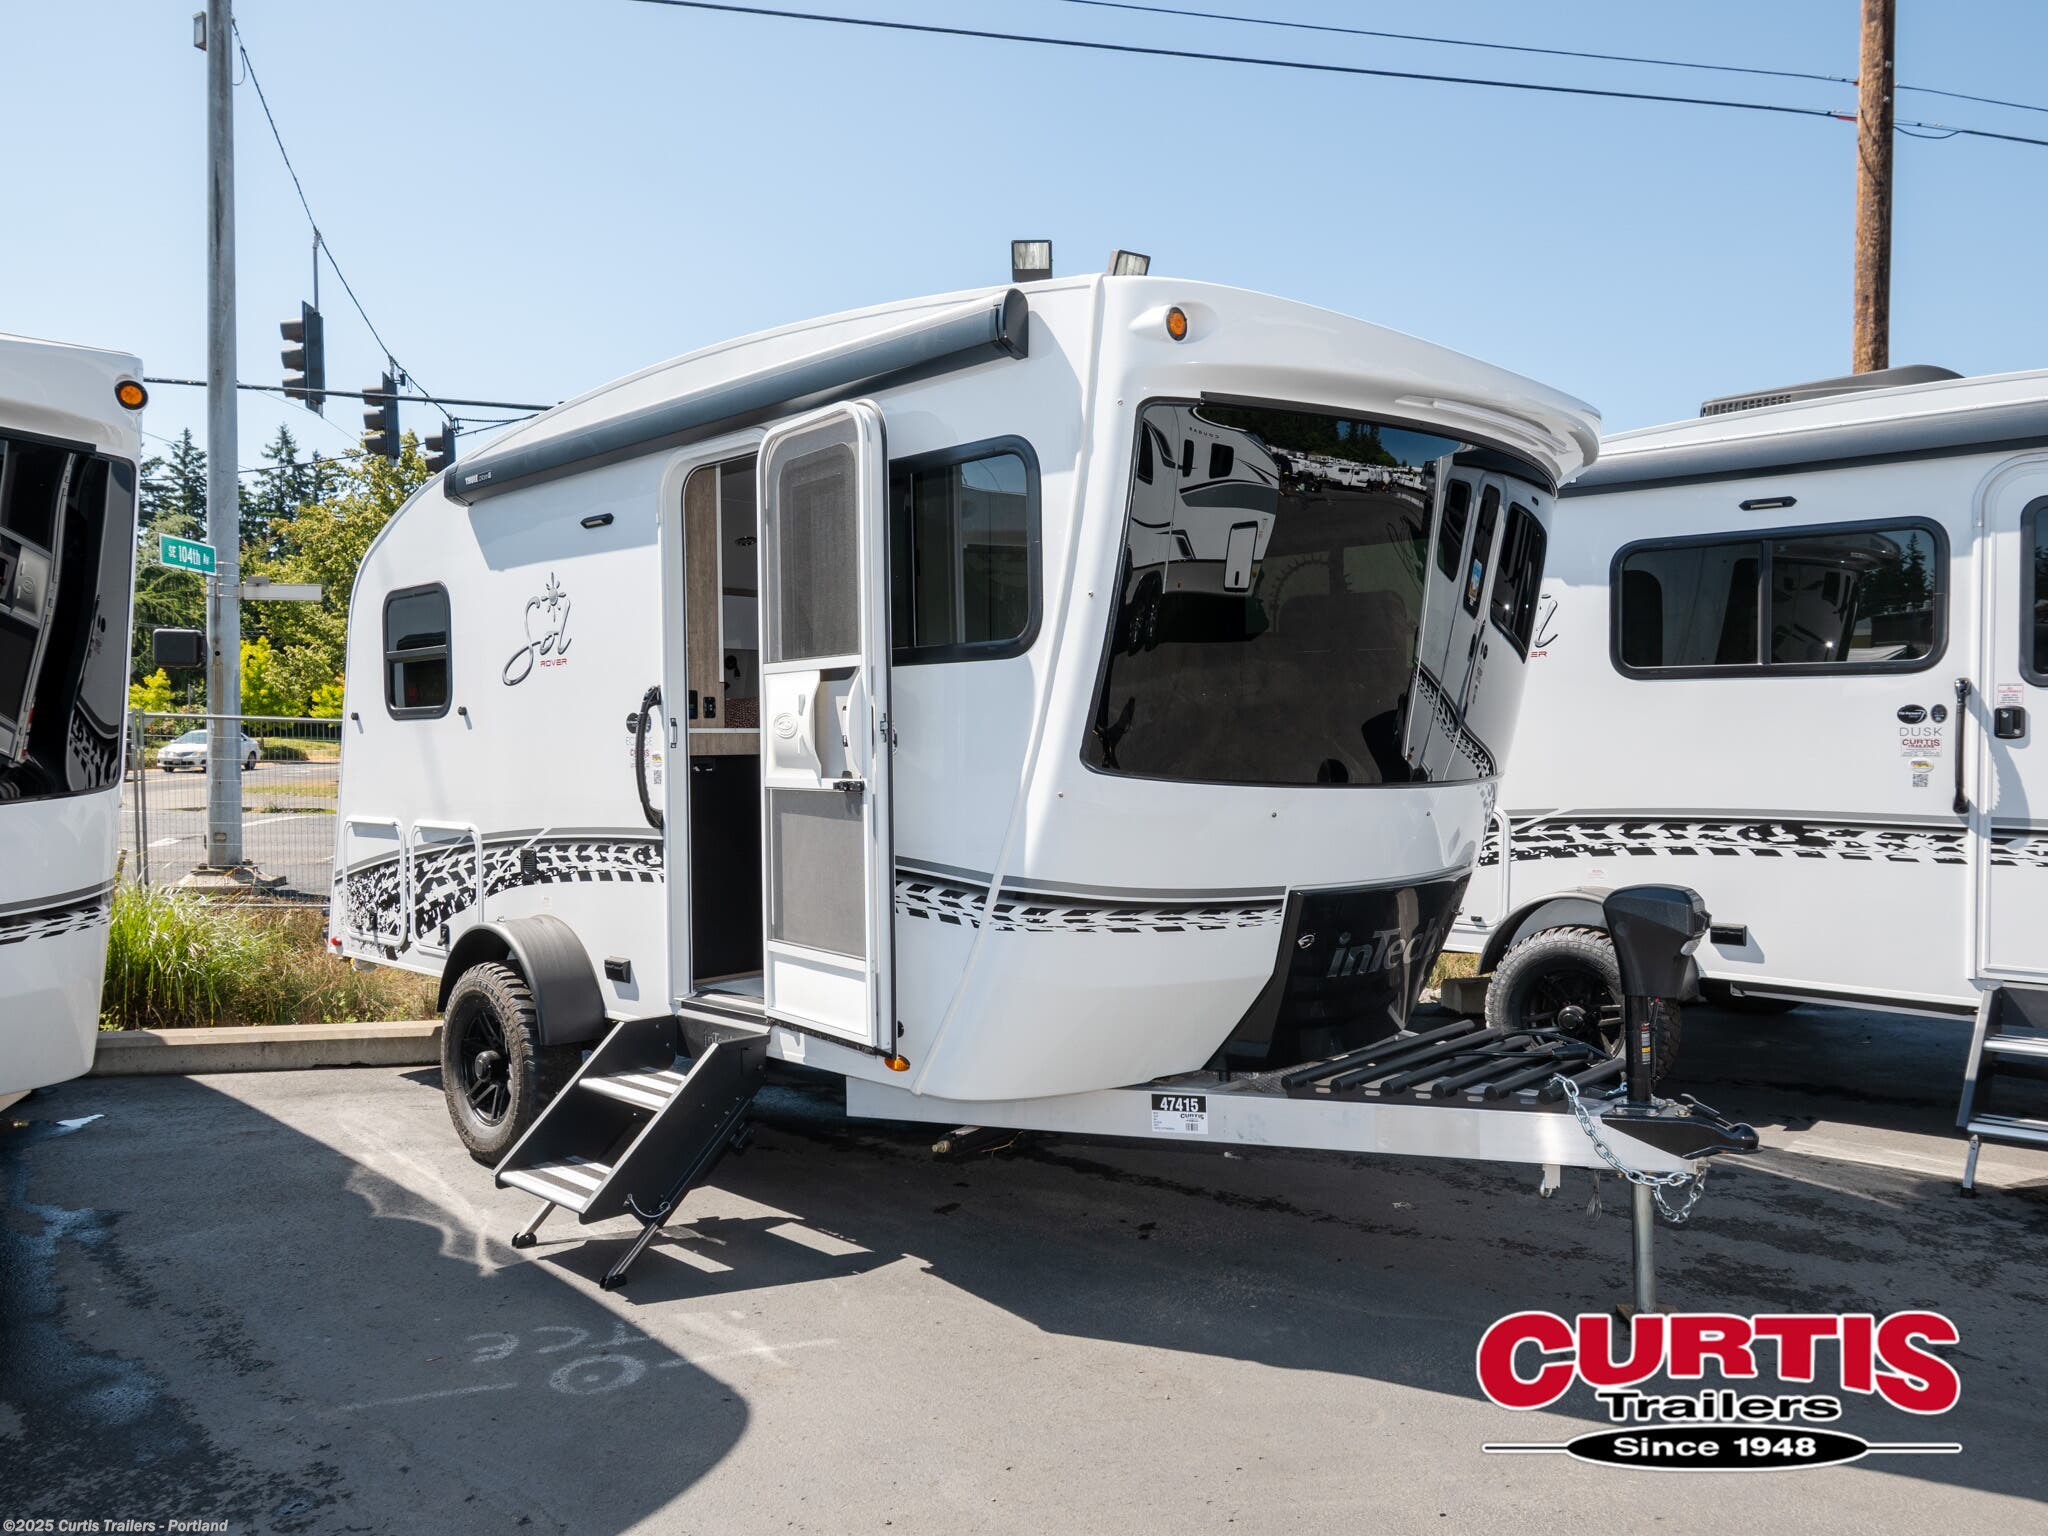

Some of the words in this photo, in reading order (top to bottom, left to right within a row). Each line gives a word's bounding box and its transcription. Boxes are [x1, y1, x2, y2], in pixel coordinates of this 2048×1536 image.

[178, 544, 201, 566] 104th
[540, 657, 568, 668] ROVER
[1899, 726, 1943, 737] DUSK
[1902, 738, 1941, 747] CURTIS
[1160, 1096, 1199, 1112] 47415
